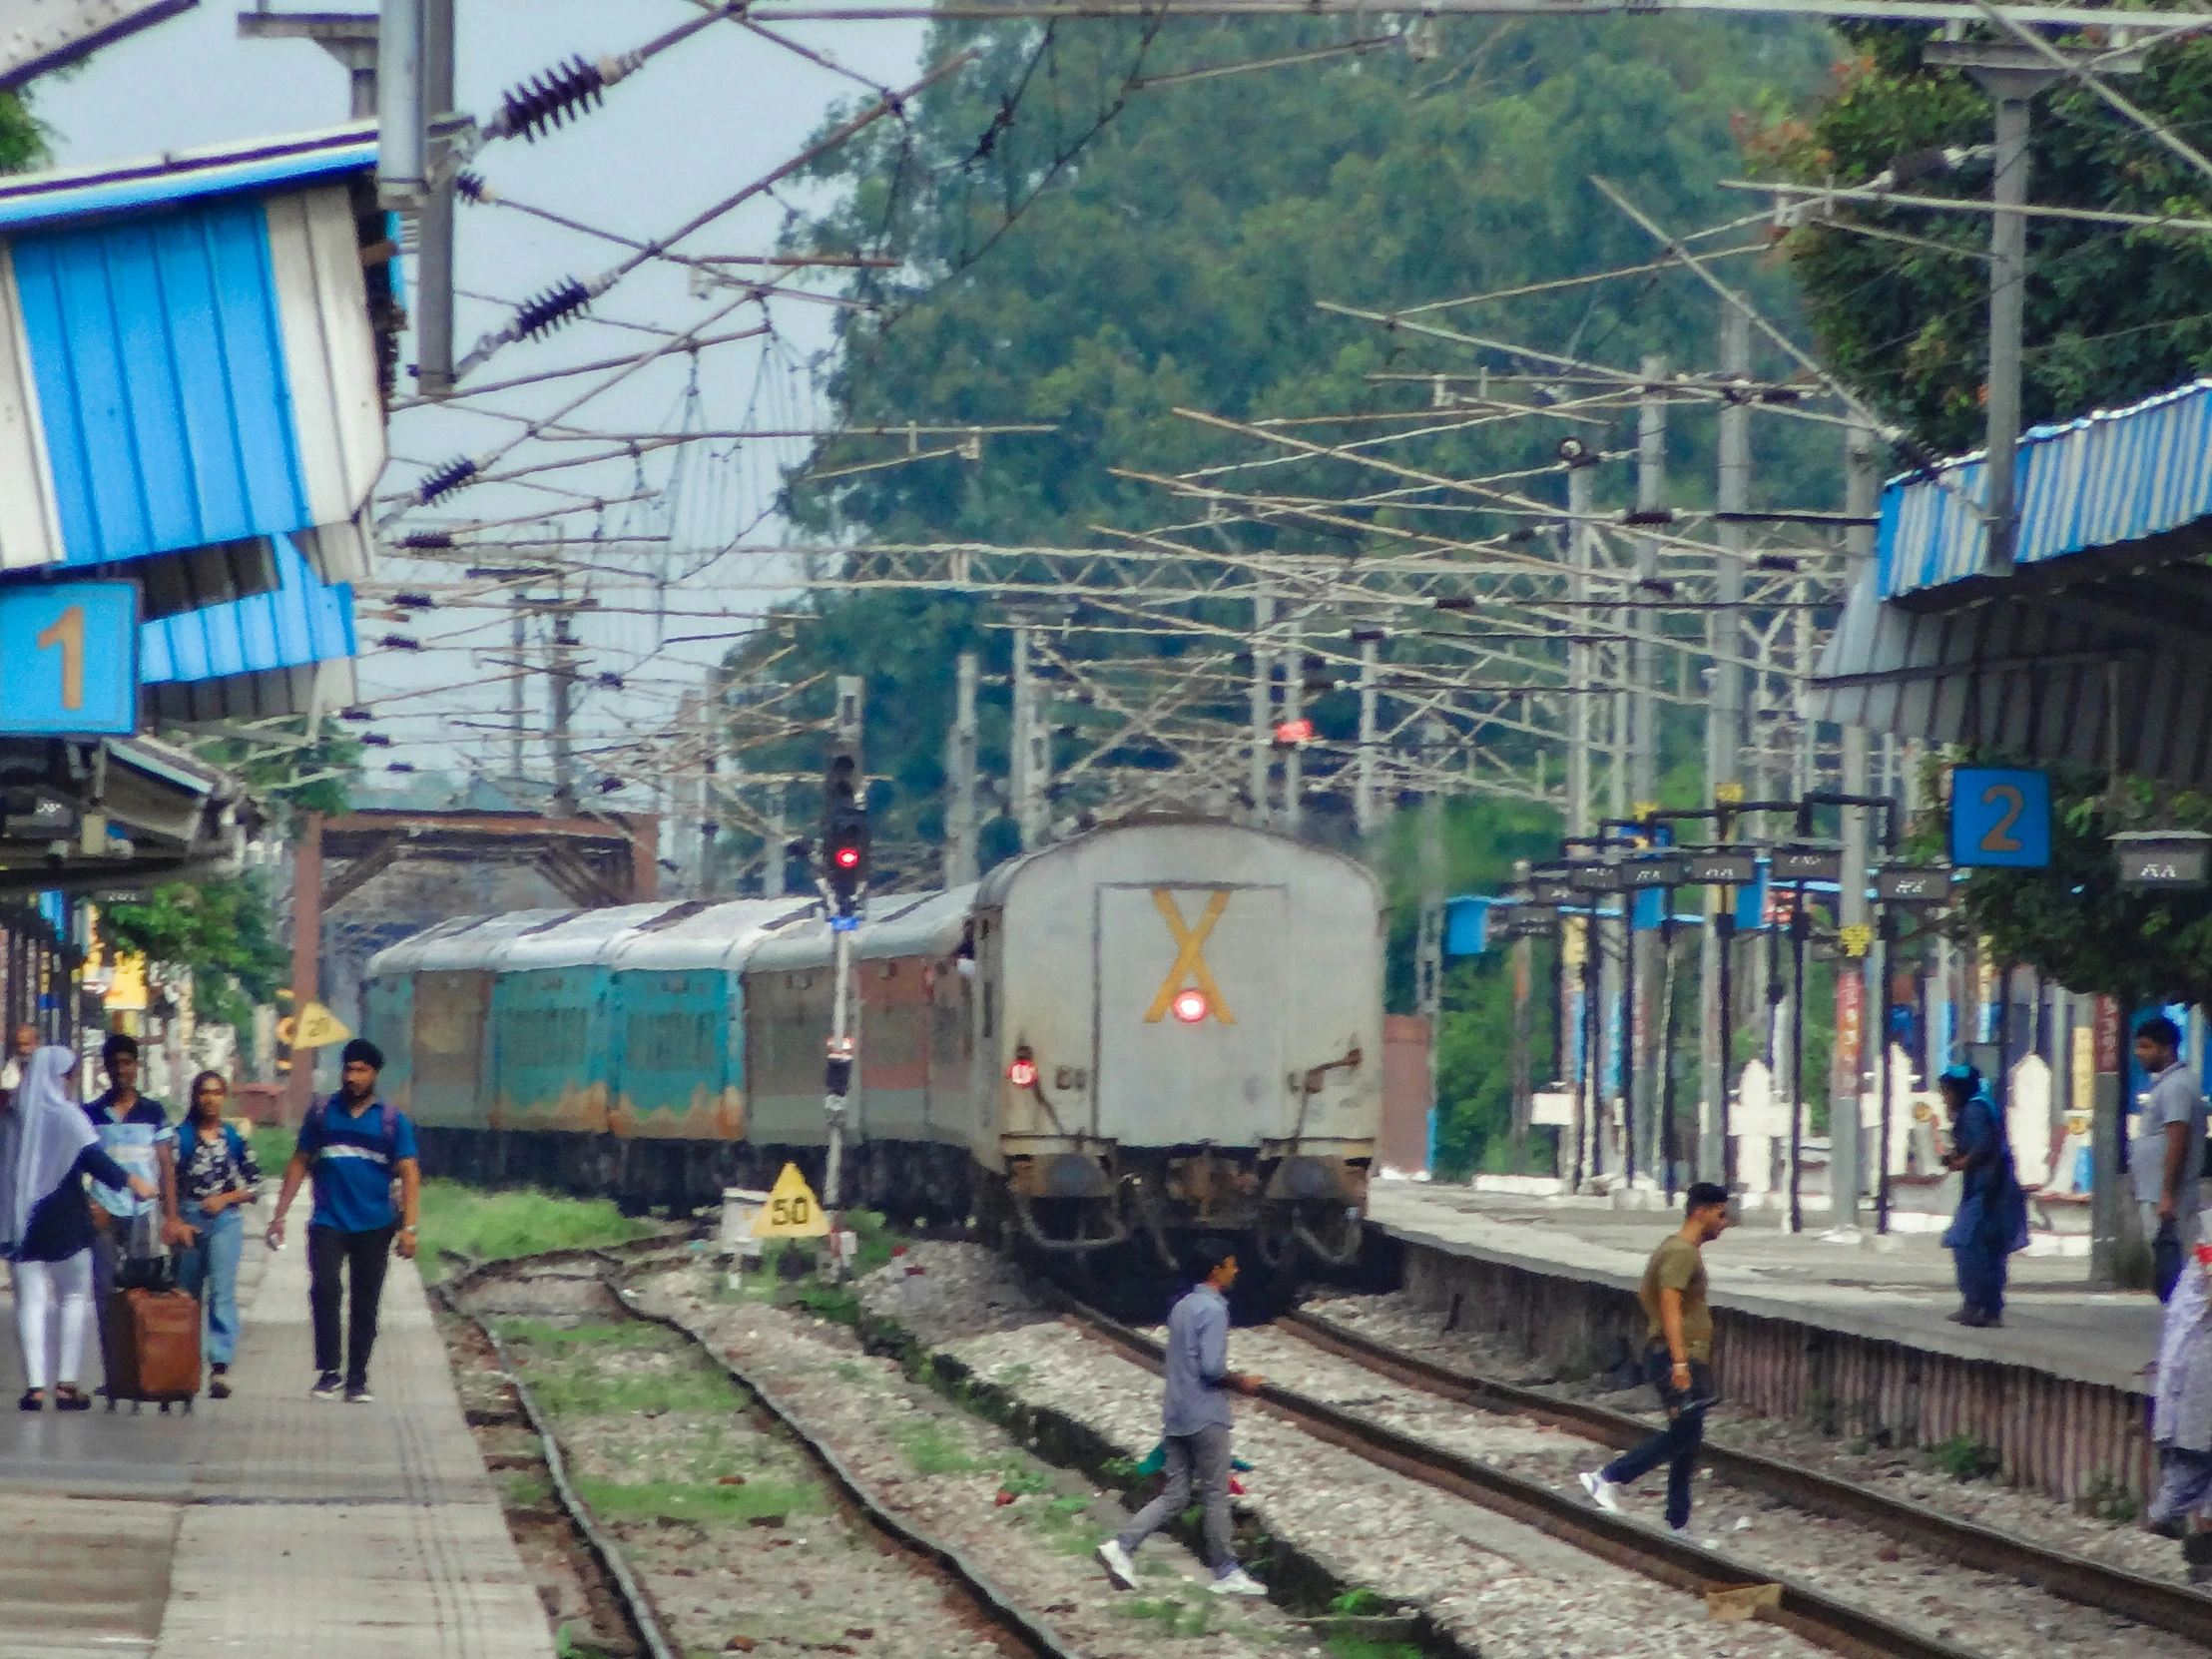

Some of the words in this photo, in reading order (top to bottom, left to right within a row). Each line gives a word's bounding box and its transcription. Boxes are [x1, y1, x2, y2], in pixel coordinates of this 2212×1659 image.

[37, 605, 84, 711] 1
[1980, 784, 2024, 851] 2
[1143, 887, 1237, 1024] X
[772, 1197, 810, 1225] 50
